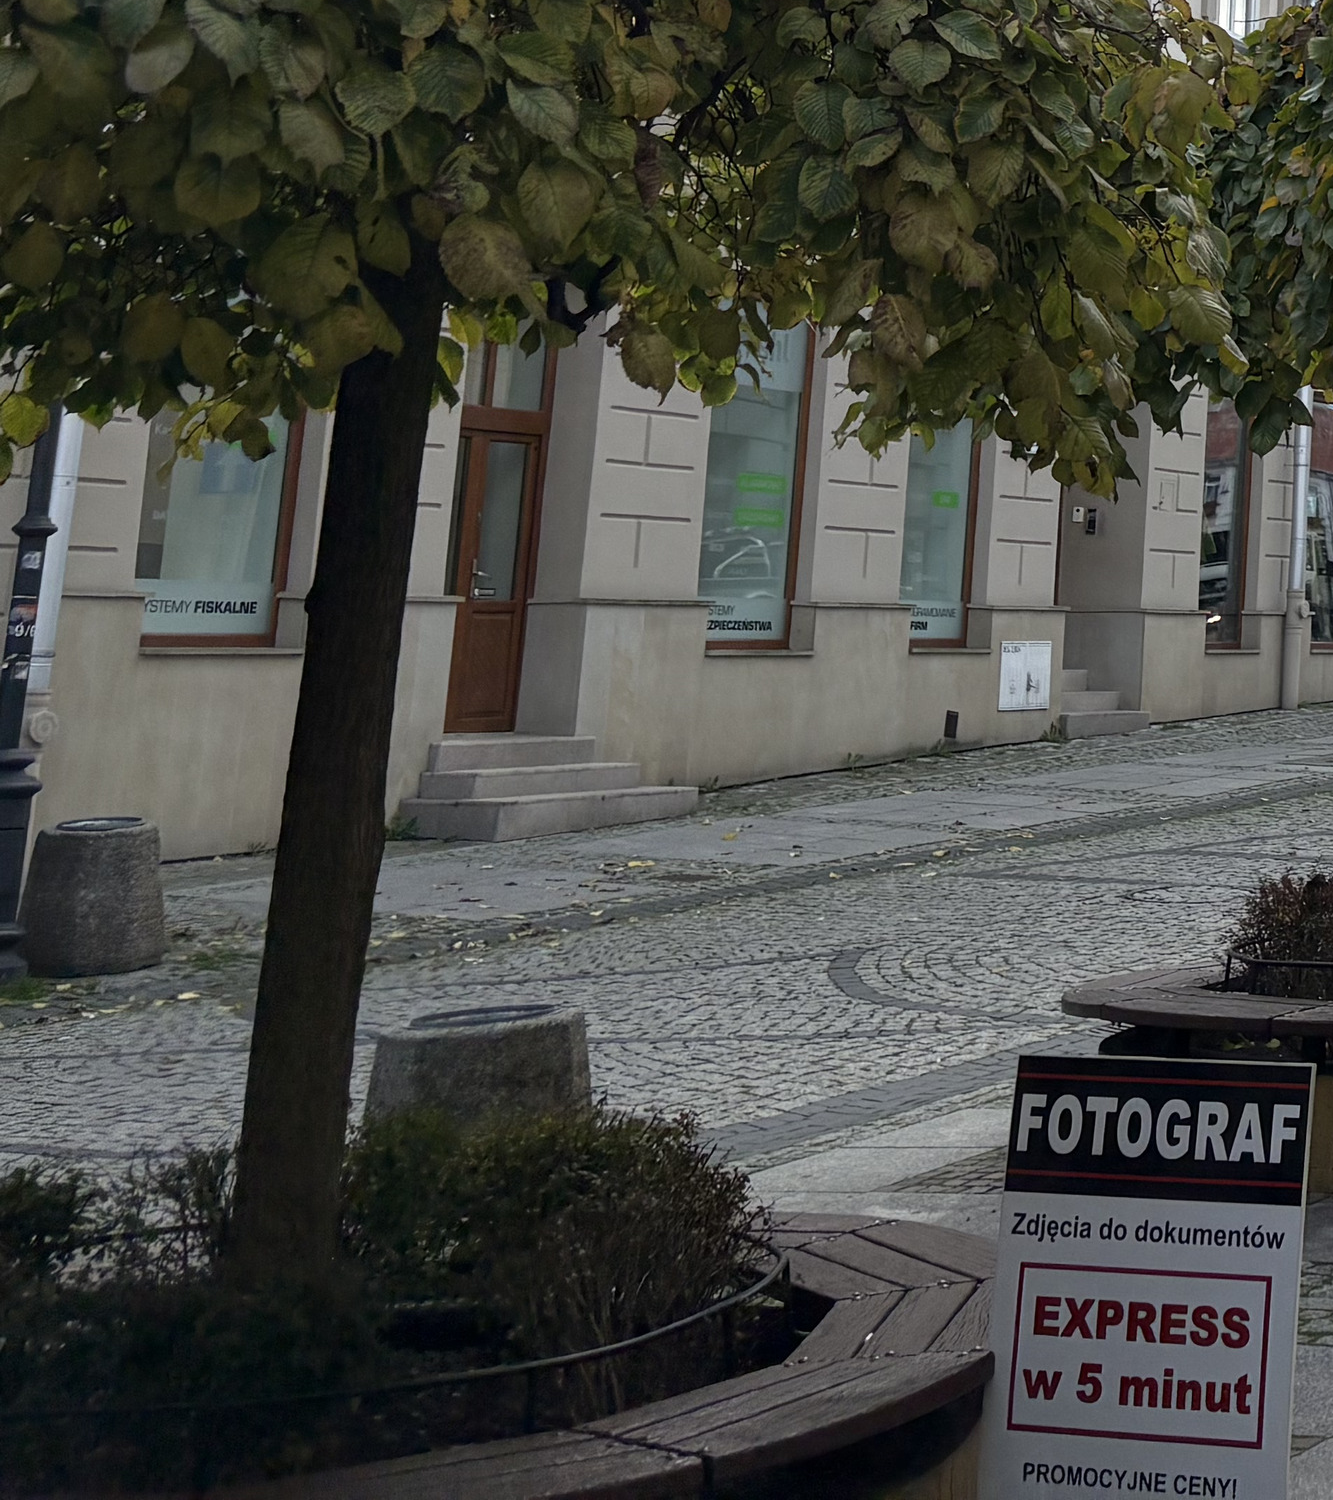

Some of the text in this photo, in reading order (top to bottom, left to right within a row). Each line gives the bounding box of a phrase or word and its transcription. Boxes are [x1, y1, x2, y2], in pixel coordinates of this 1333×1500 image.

[193, 600, 258, 615] FISKALNE
[1016, 1093, 1301, 1164] FOTOGRAF
[1011, 1212, 1286, 1250] Zdjęcia do dokumentów
[1033, 1296, 1251, 1349] EXPRESS
[1023, 1363, 1252, 1415] w 5 minut
[1022, 1462, 1238, 1499] PROMOCYJNE CENY!
